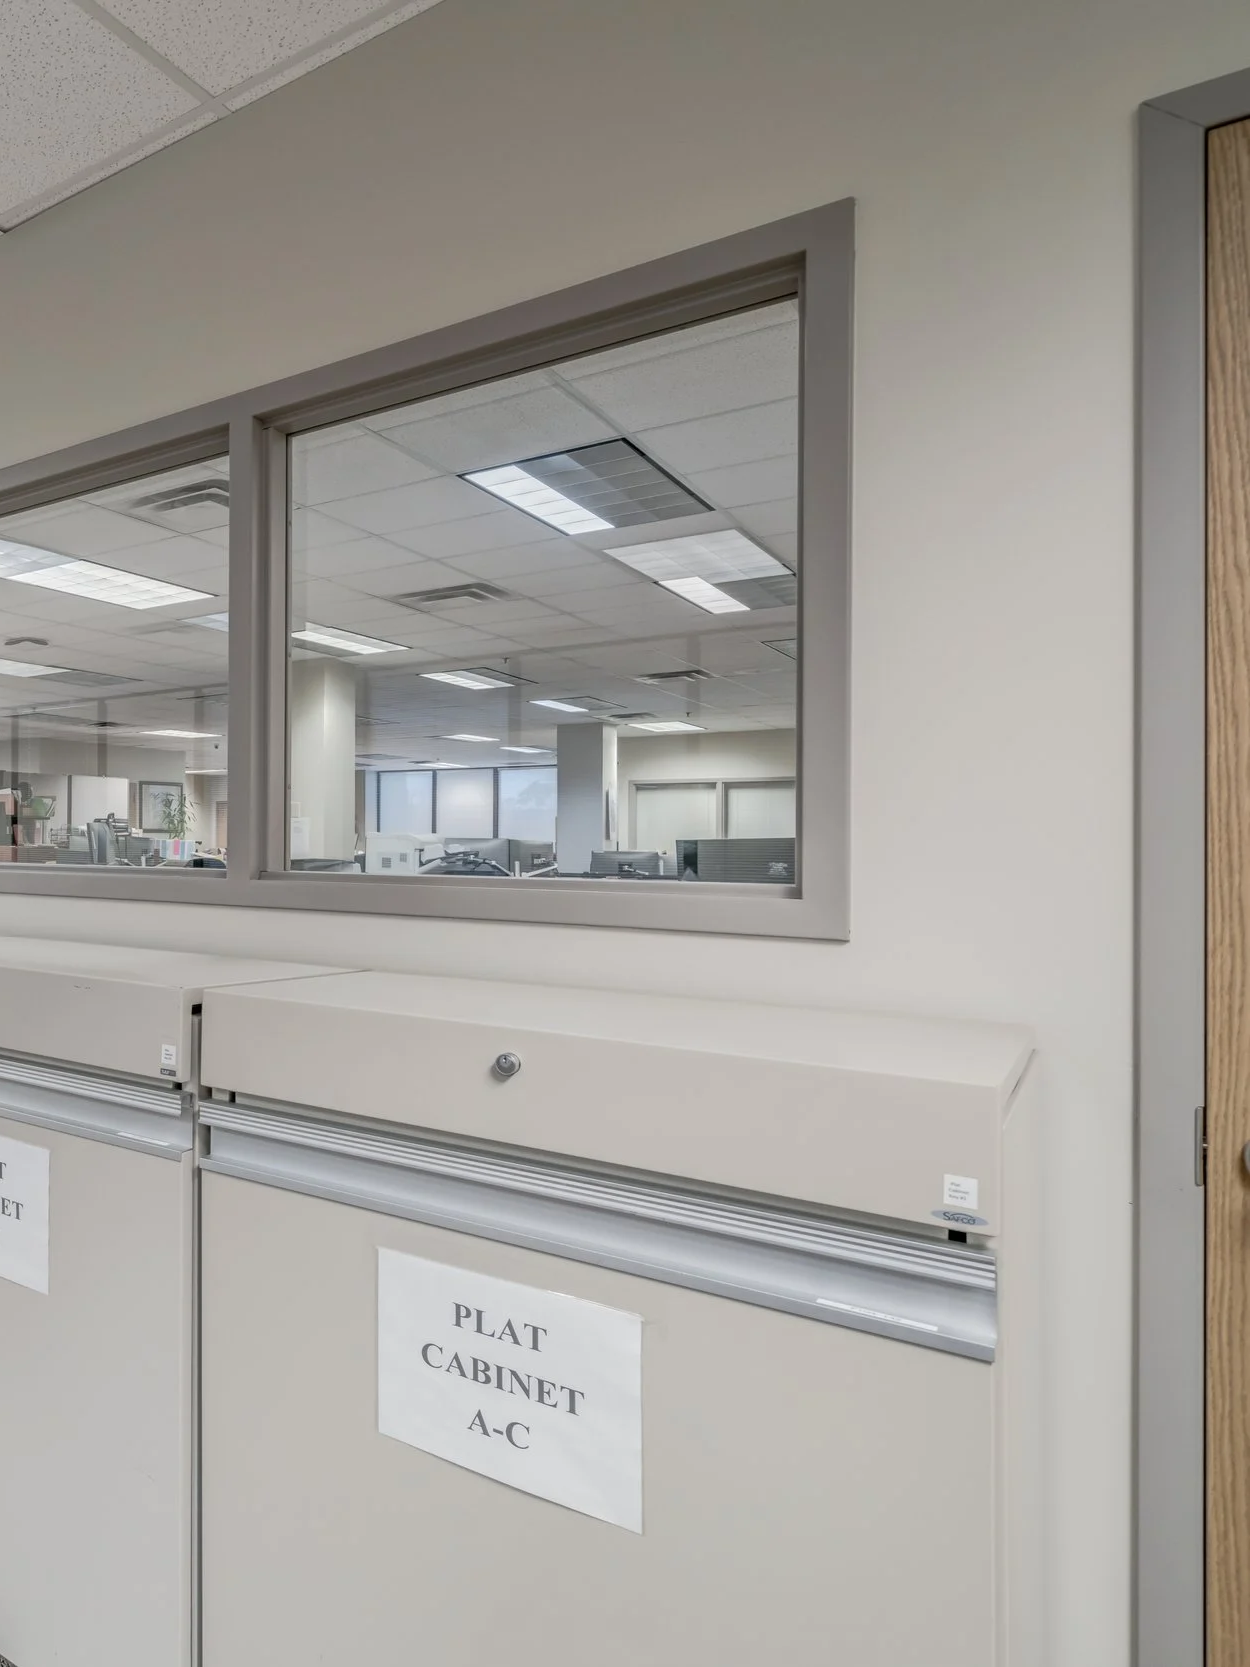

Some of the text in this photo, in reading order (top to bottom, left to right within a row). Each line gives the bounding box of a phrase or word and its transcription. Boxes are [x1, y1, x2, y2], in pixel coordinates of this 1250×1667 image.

[942, 1211, 976, 1225] SAFCO
[452, 1302, 547, 1352] PLAT
[421, 1343, 585, 1416] CABINET
[467, 1409, 531, 1450] A-C
